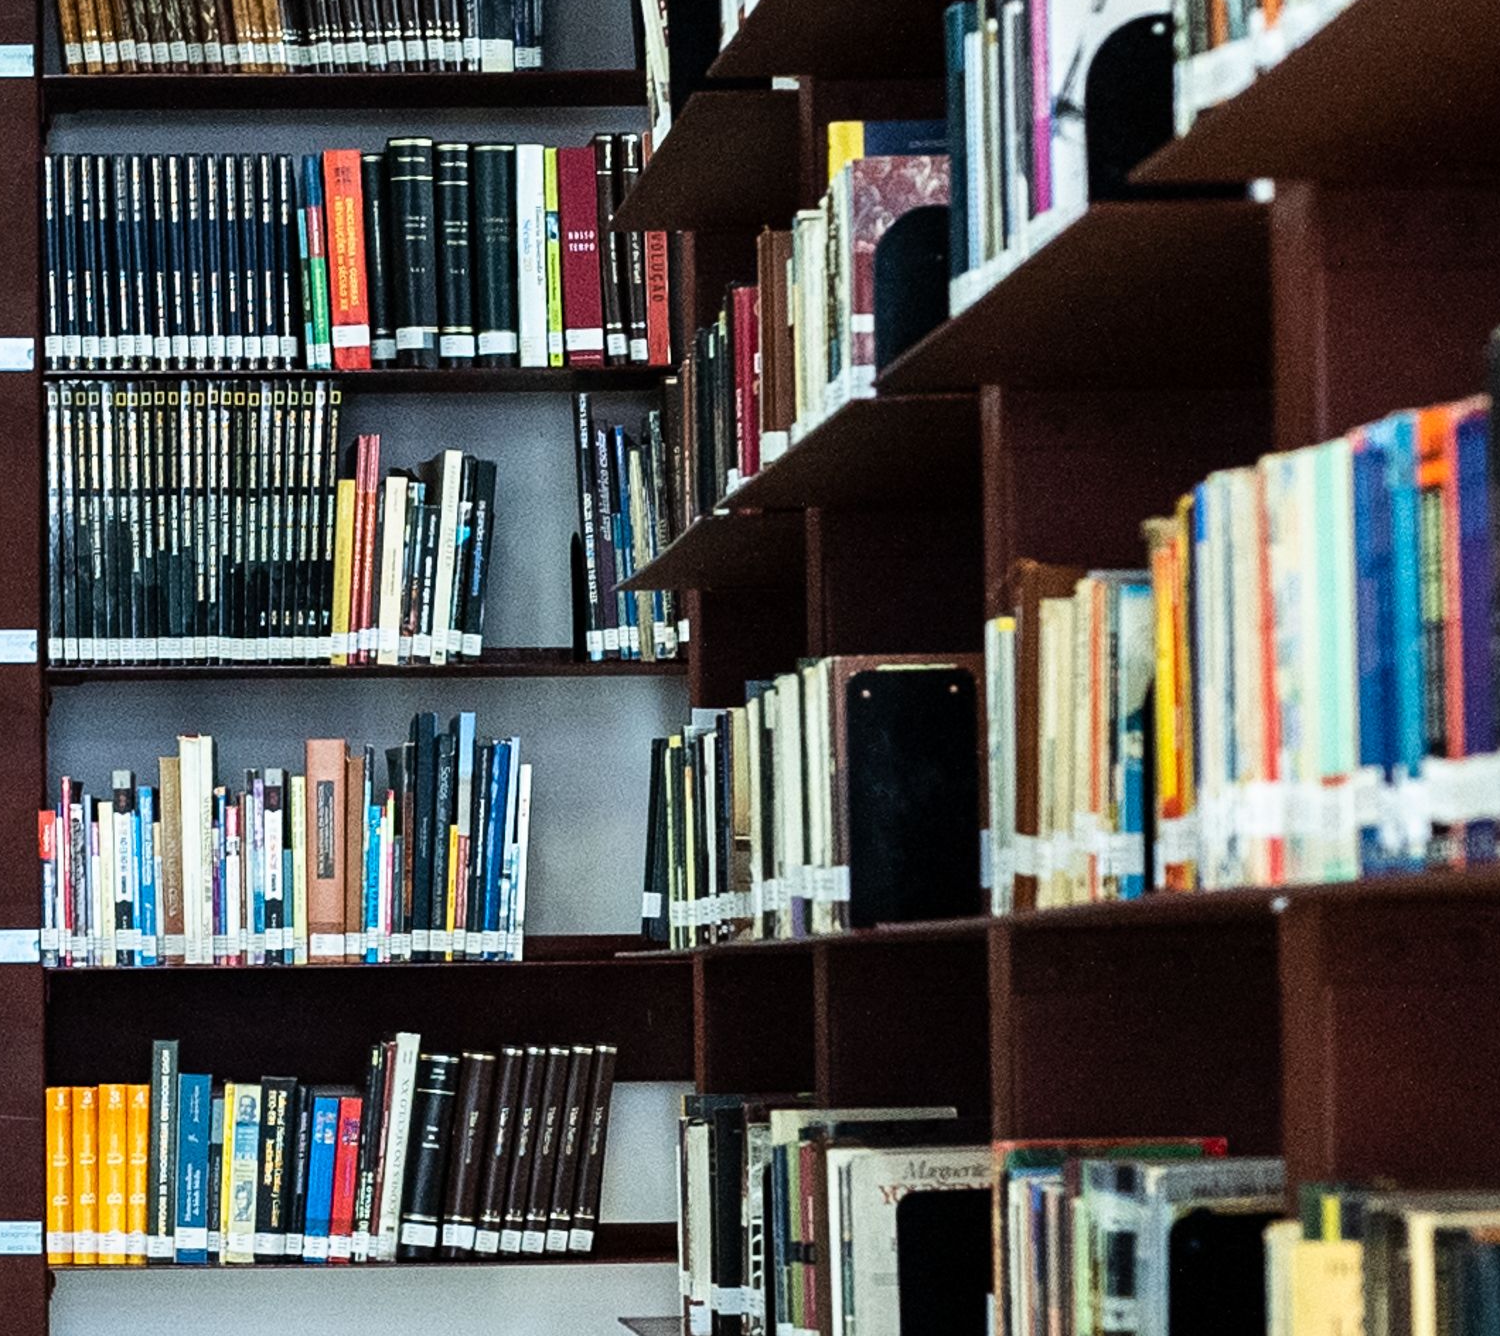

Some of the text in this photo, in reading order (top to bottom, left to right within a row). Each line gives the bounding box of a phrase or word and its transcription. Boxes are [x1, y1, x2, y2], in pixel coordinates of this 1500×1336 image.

[651, 231, 665, 303] VOLUÇÃO
[595, 429, 609, 468] escolar
[597, 469, 611, 515] histórico
[439, 765, 451, 799] Santos
[57, 1091, 65, 1107] 1
[83, 1090, 93, 1104] 2
[109, 1090, 121, 1104] 3
[135, 1090, 146, 1104] 4
[385, 1077, 411, 1216] ÍCONES DO SÉCULO XX
